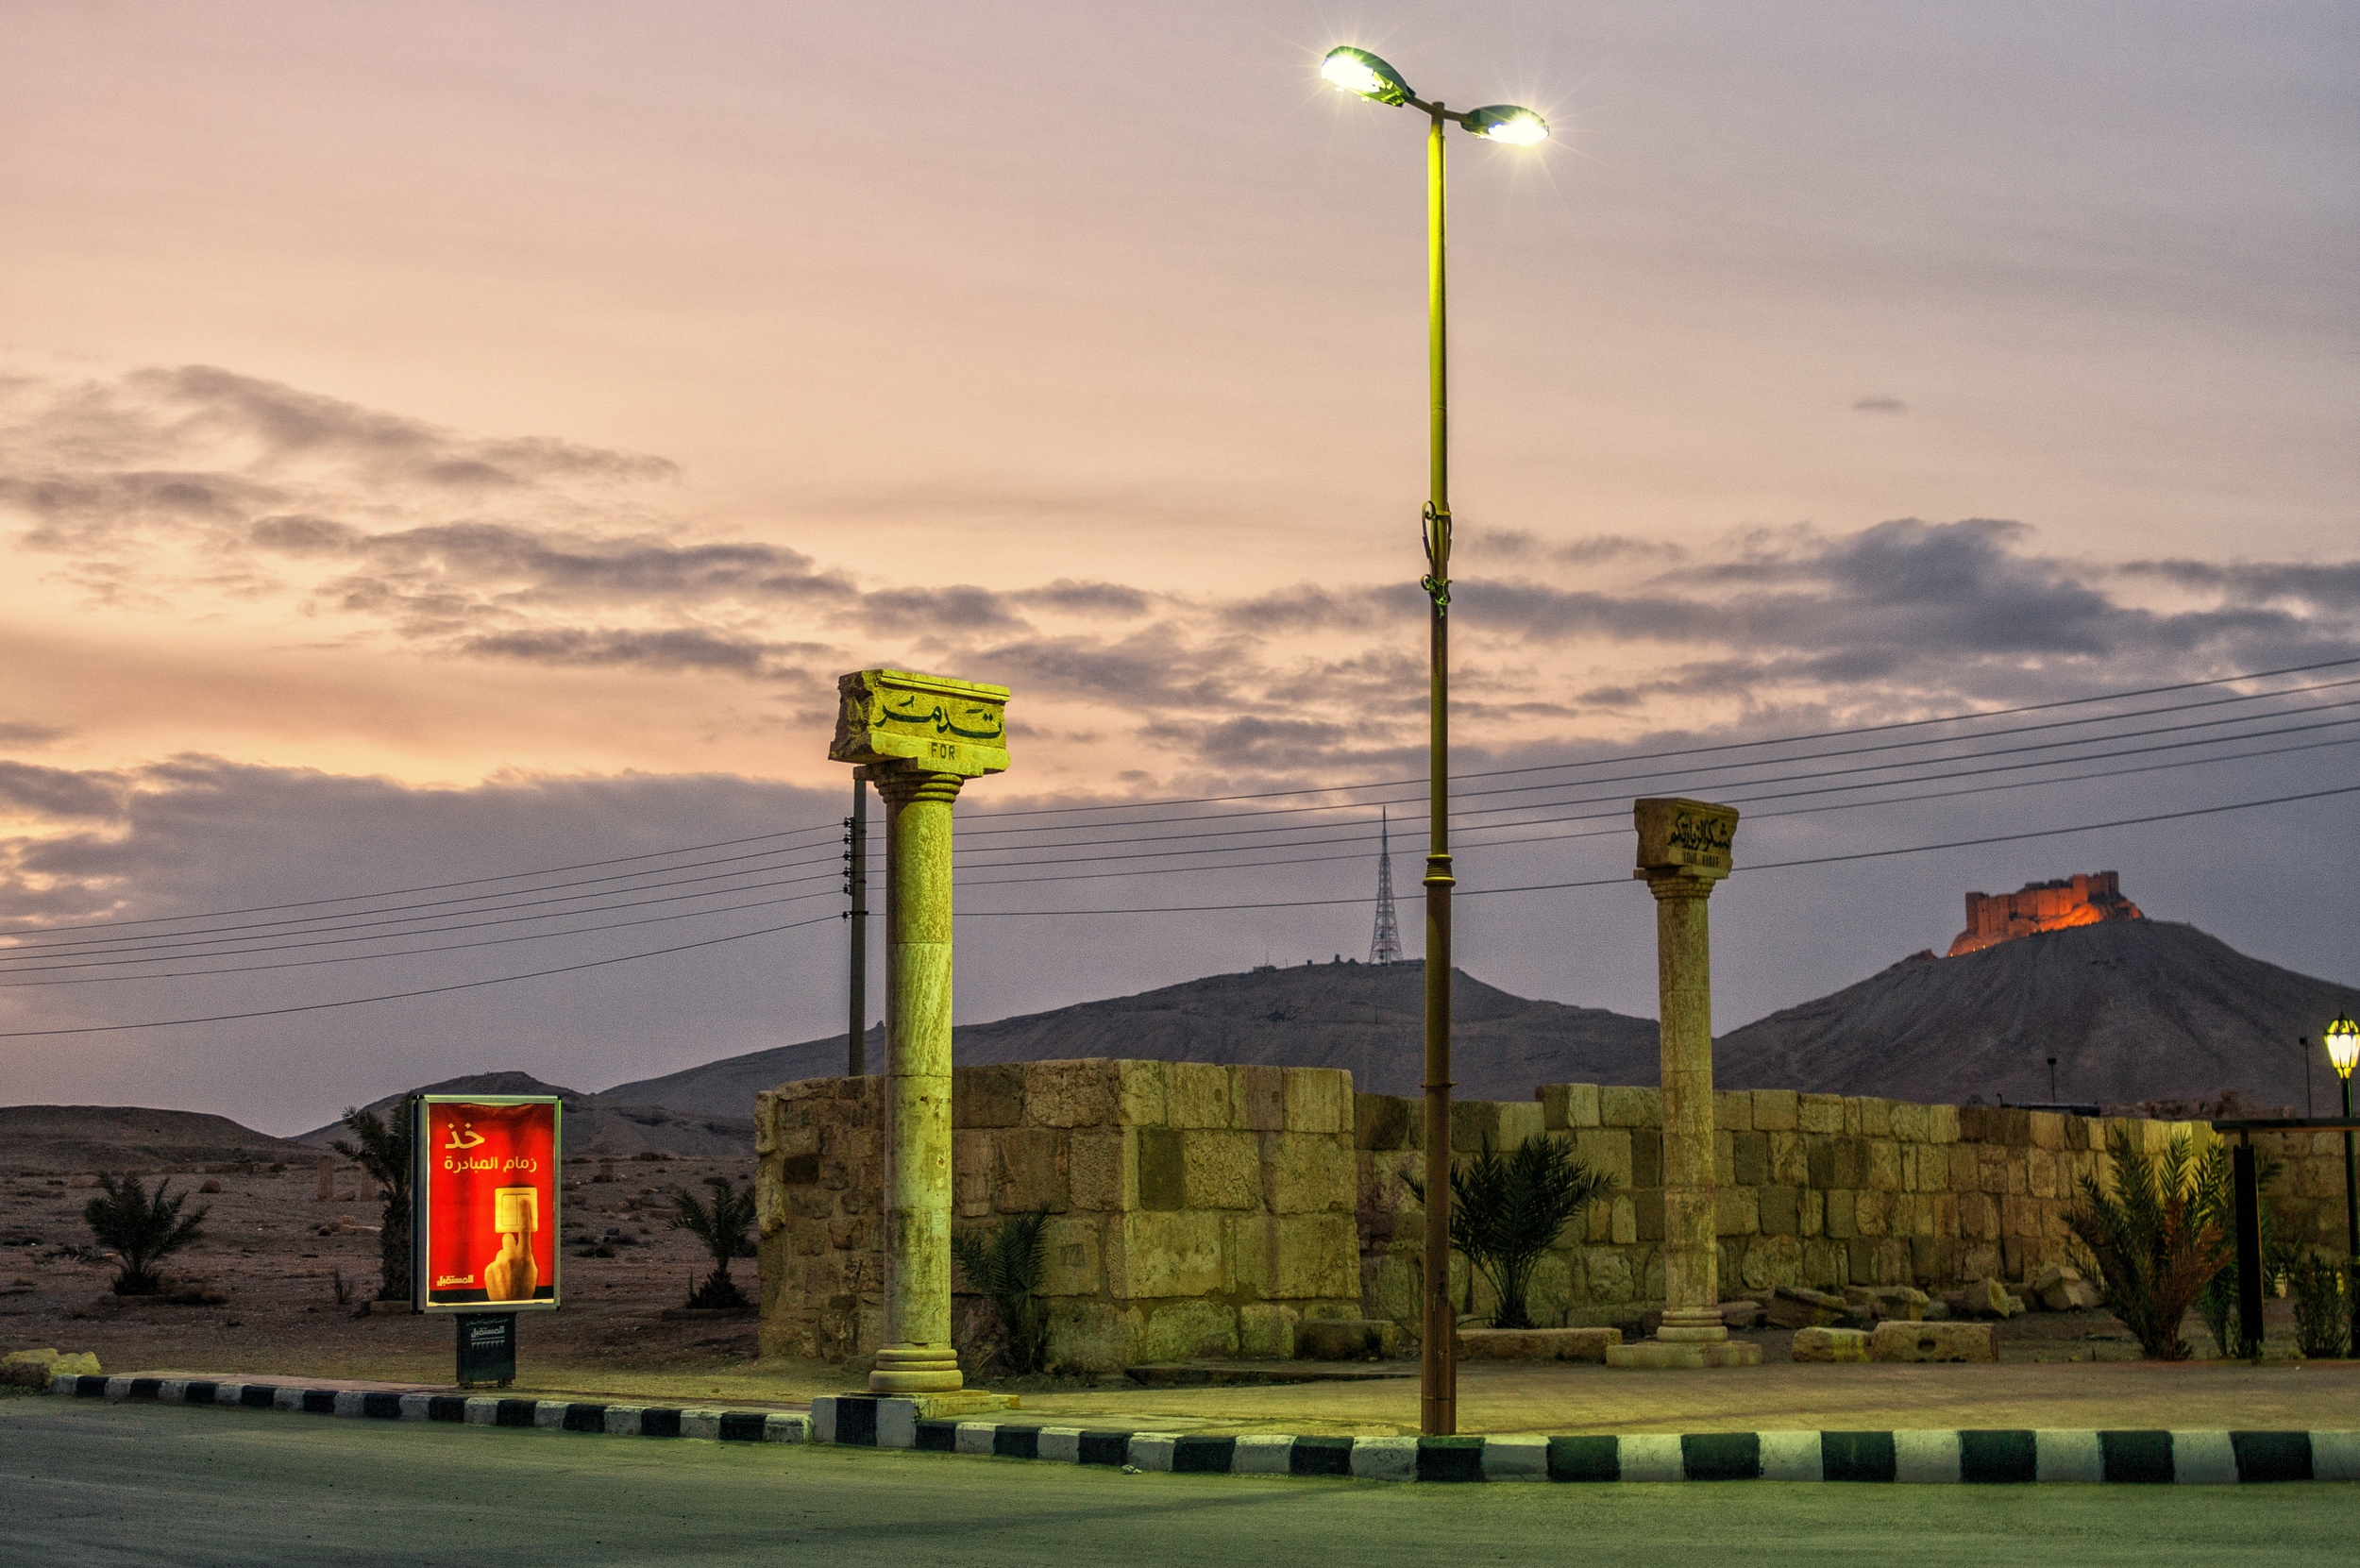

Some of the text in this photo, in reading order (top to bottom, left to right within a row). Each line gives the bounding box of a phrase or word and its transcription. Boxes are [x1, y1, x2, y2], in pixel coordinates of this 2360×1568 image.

[931, 742, 955, 760] FOR
[445, 1121, 485, 1149] خذ
[444, 1156, 537, 1173] زمام المبادرة
[437, 1274, 474, 1287] المستقبل
[470, 1325, 505, 1338] المستقبل
